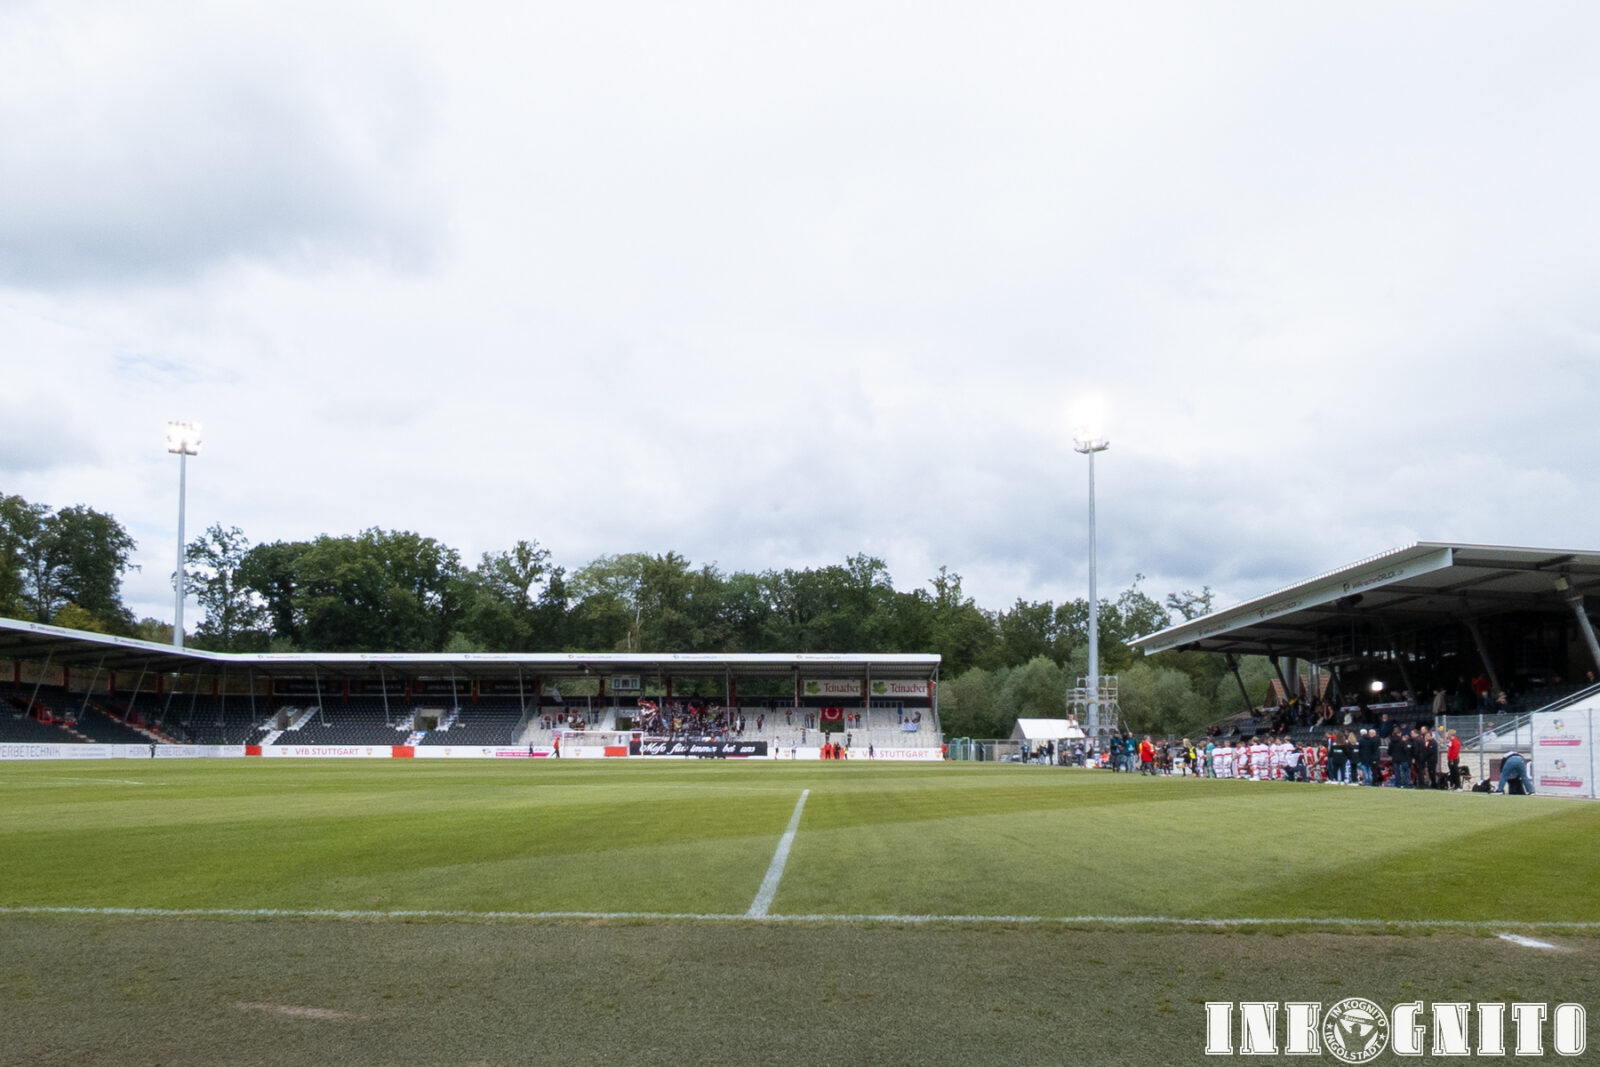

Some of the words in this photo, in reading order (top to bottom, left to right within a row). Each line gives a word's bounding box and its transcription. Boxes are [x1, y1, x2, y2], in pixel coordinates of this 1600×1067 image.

[823, 682, 860, 693] Teinacher
[890, 682, 927, 693] Teinacher
[722, 743, 736, 753] bei
